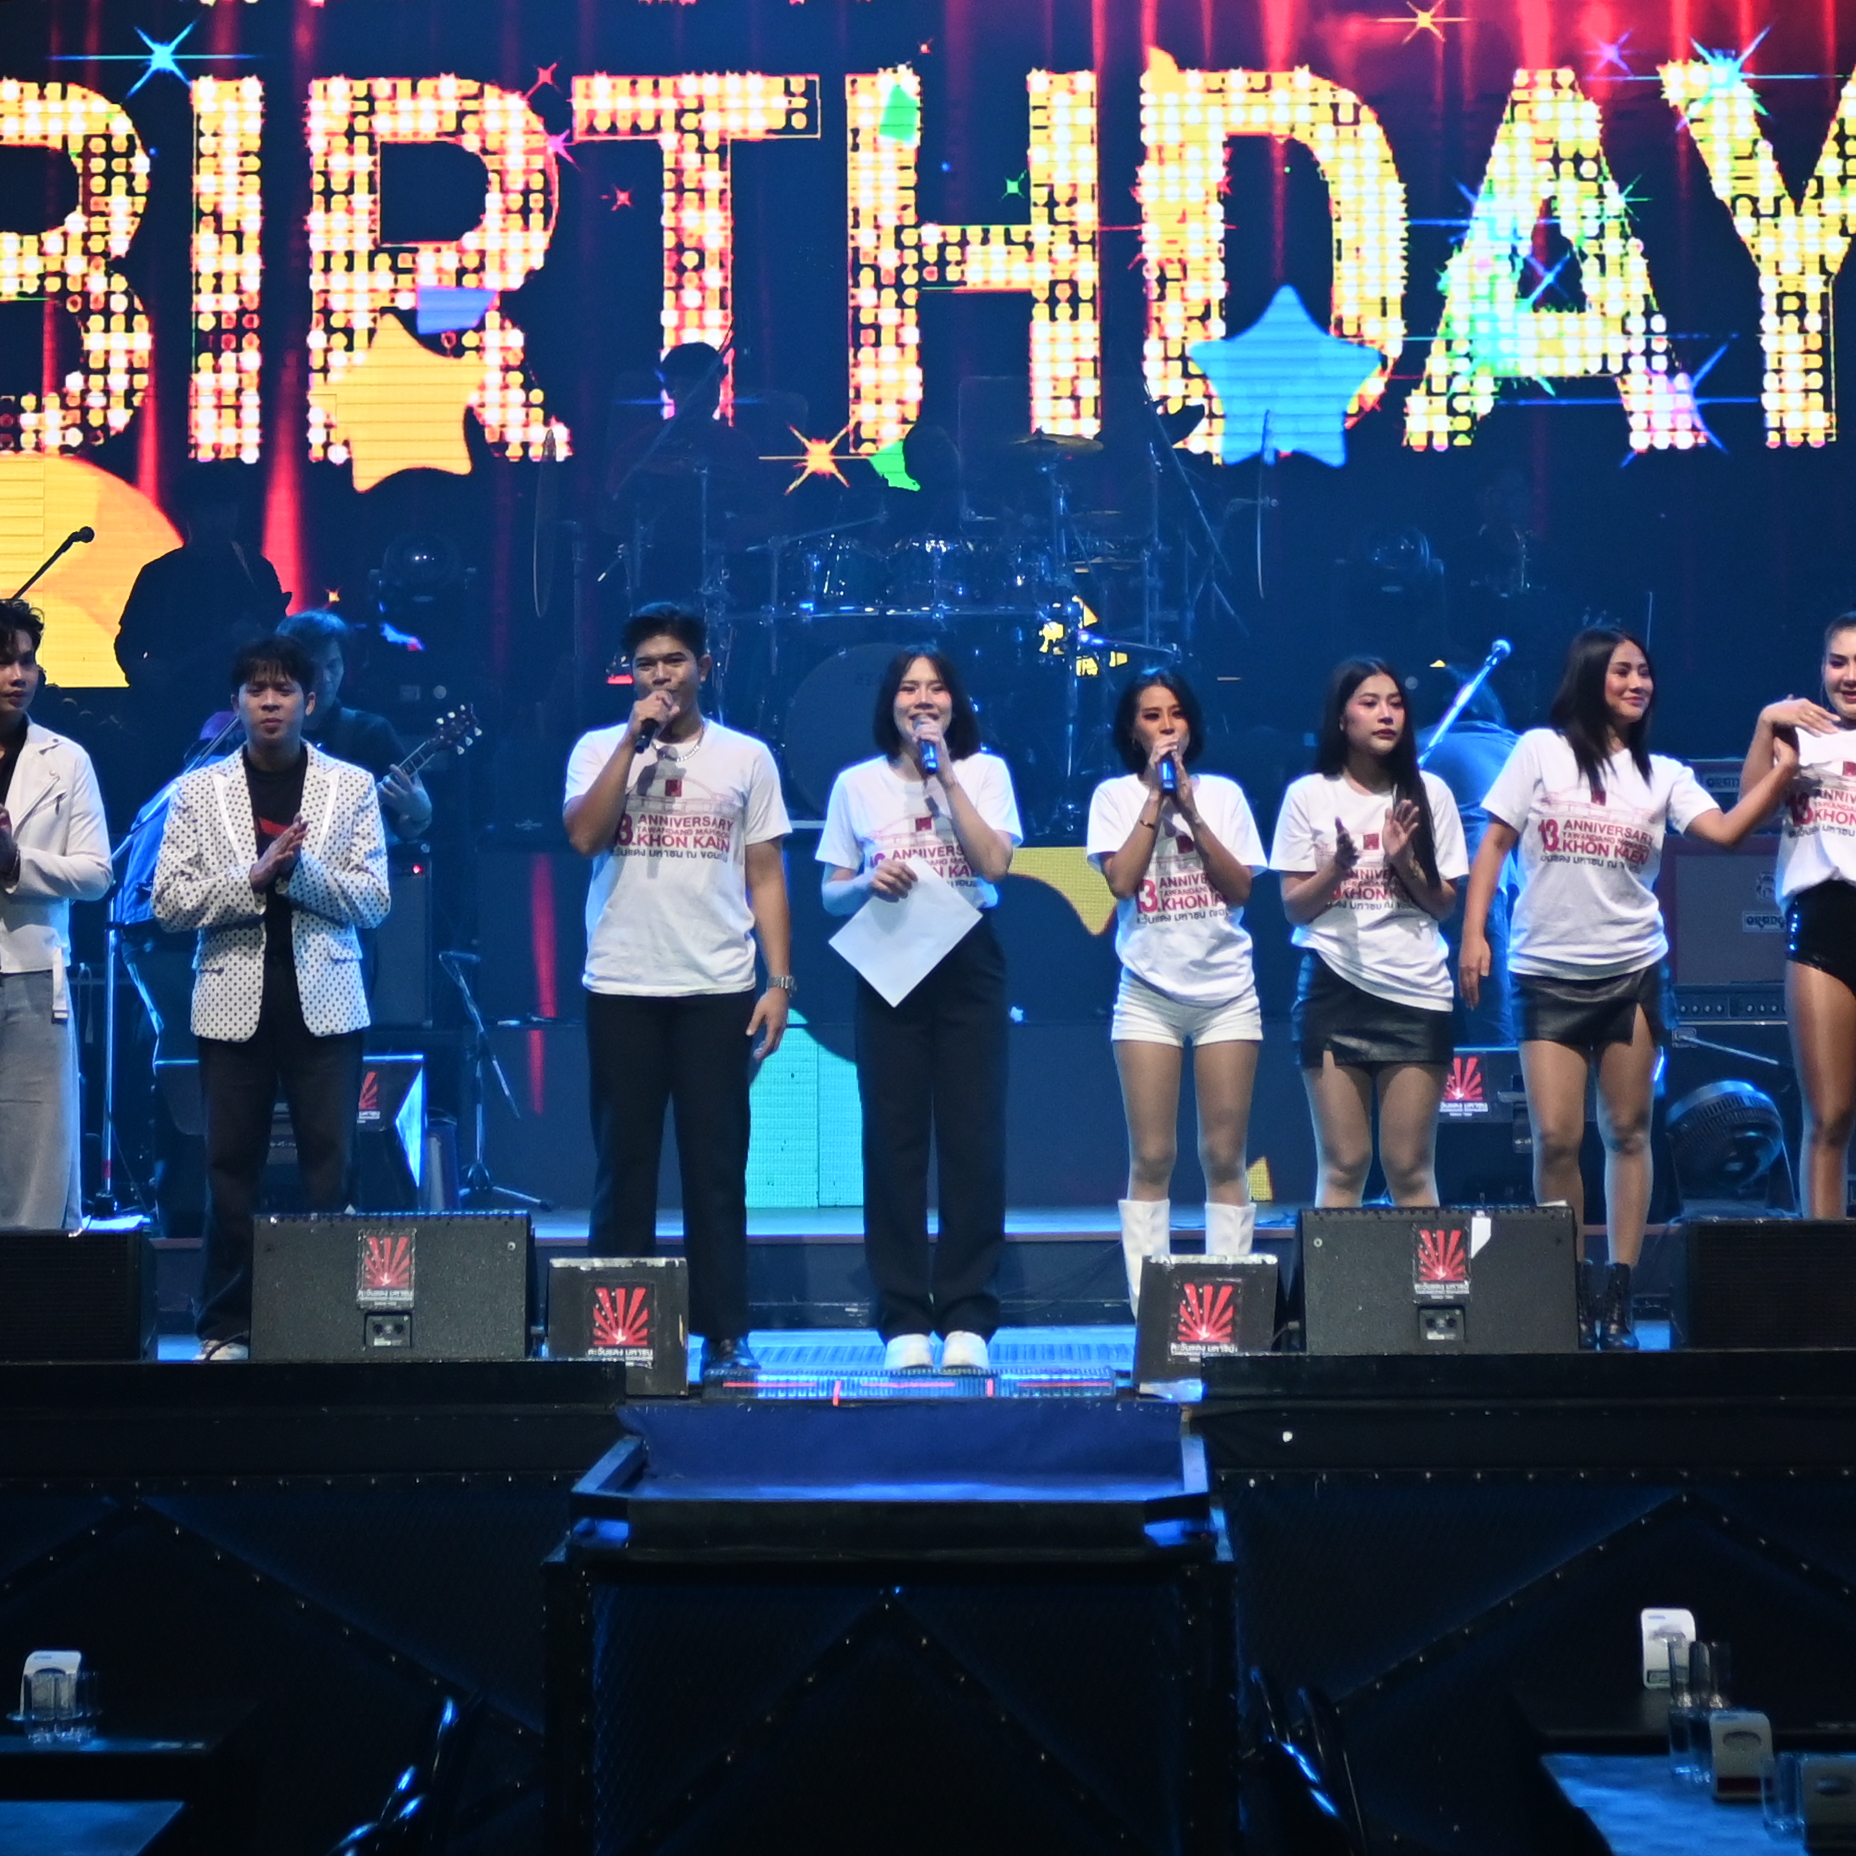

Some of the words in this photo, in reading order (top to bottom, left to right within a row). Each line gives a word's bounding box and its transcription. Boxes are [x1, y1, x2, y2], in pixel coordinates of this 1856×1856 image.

[638, 814, 734, 832] ANNIVERSARY
[638, 834, 688, 848] KHON
[1564, 819, 1654, 846] ANNIVERSARY
[892, 845, 966, 861] ANNIVERS
[1563, 840, 1610, 857] KHON
[1162, 894, 1208, 911] KHON
